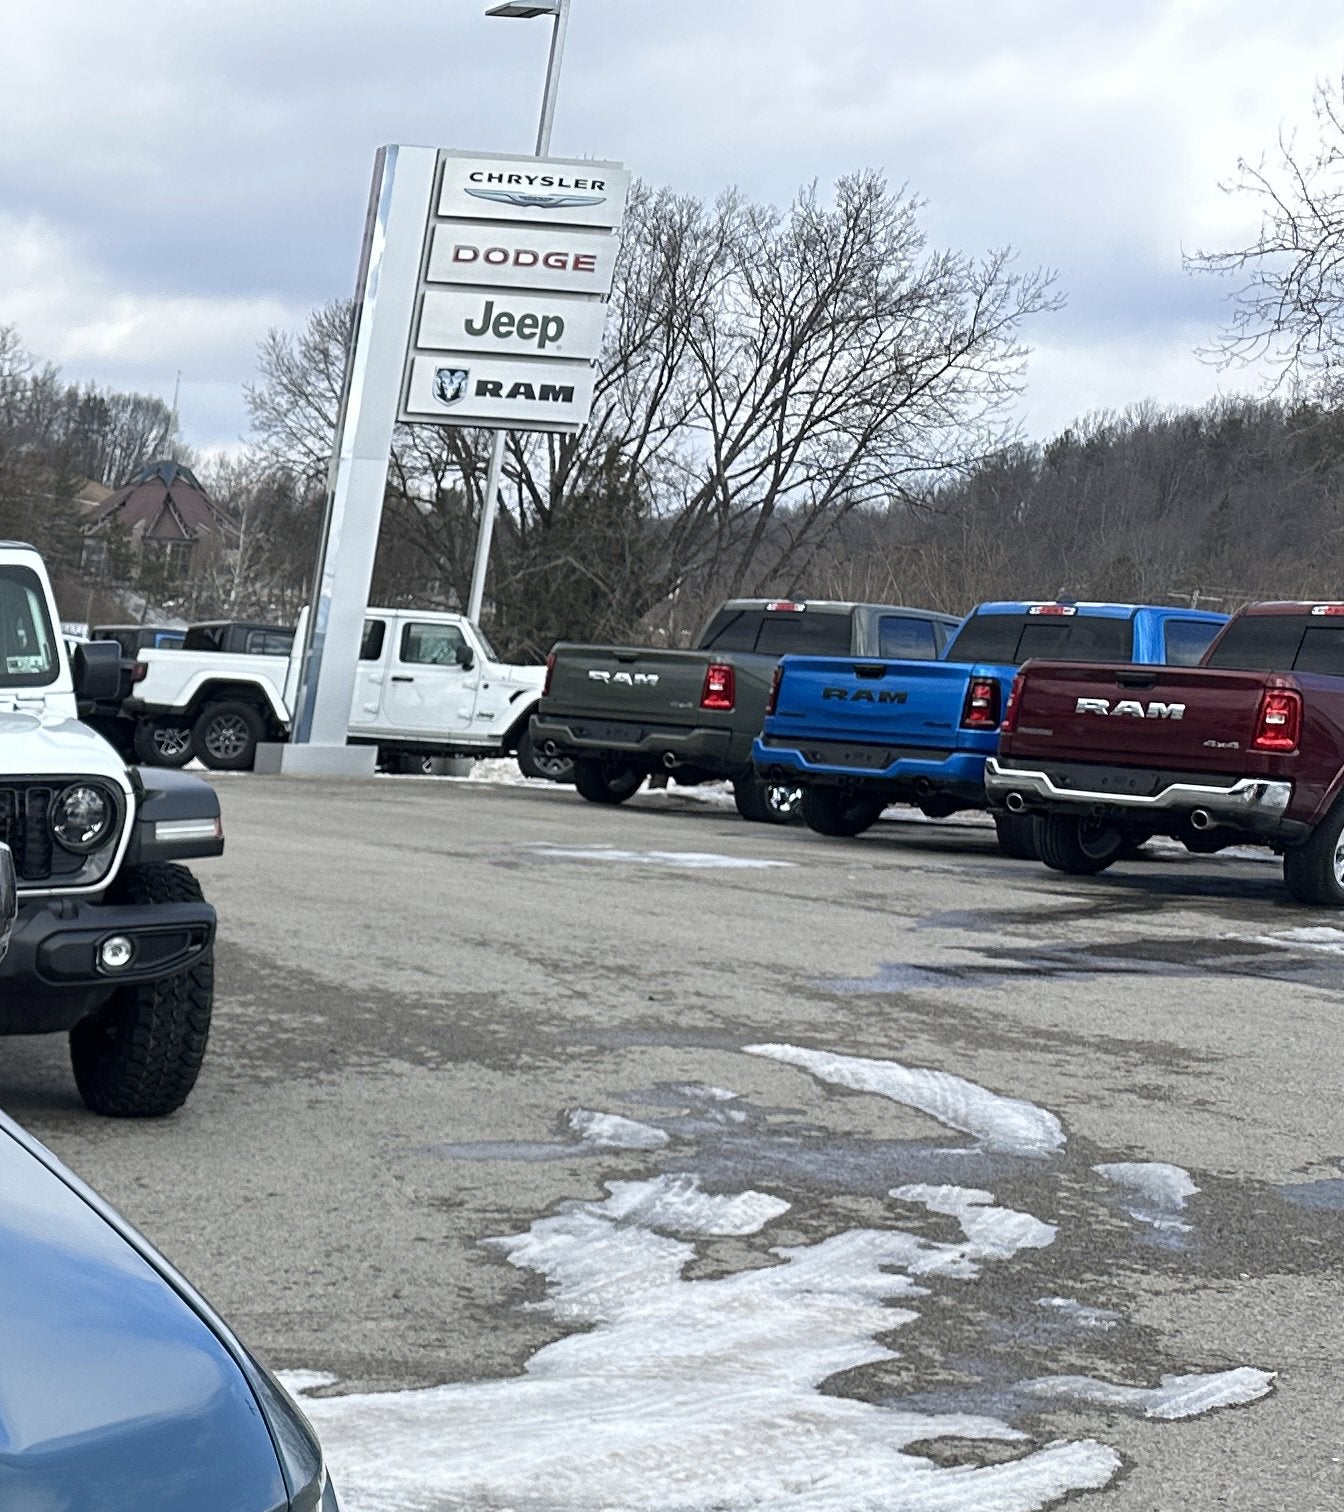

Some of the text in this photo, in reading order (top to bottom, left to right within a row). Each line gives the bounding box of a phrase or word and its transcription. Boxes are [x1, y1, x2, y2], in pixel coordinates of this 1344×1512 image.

[469, 172, 606, 191] CHRYSLER
[452, 245, 597, 273] DODGE
[464, 300, 564, 349] Jeep
[475, 379, 574, 403] RAM
[588, 670, 660, 687] RAM
[823, 687, 908, 704] RAM
[1075, 697, 1186, 720] RAM
